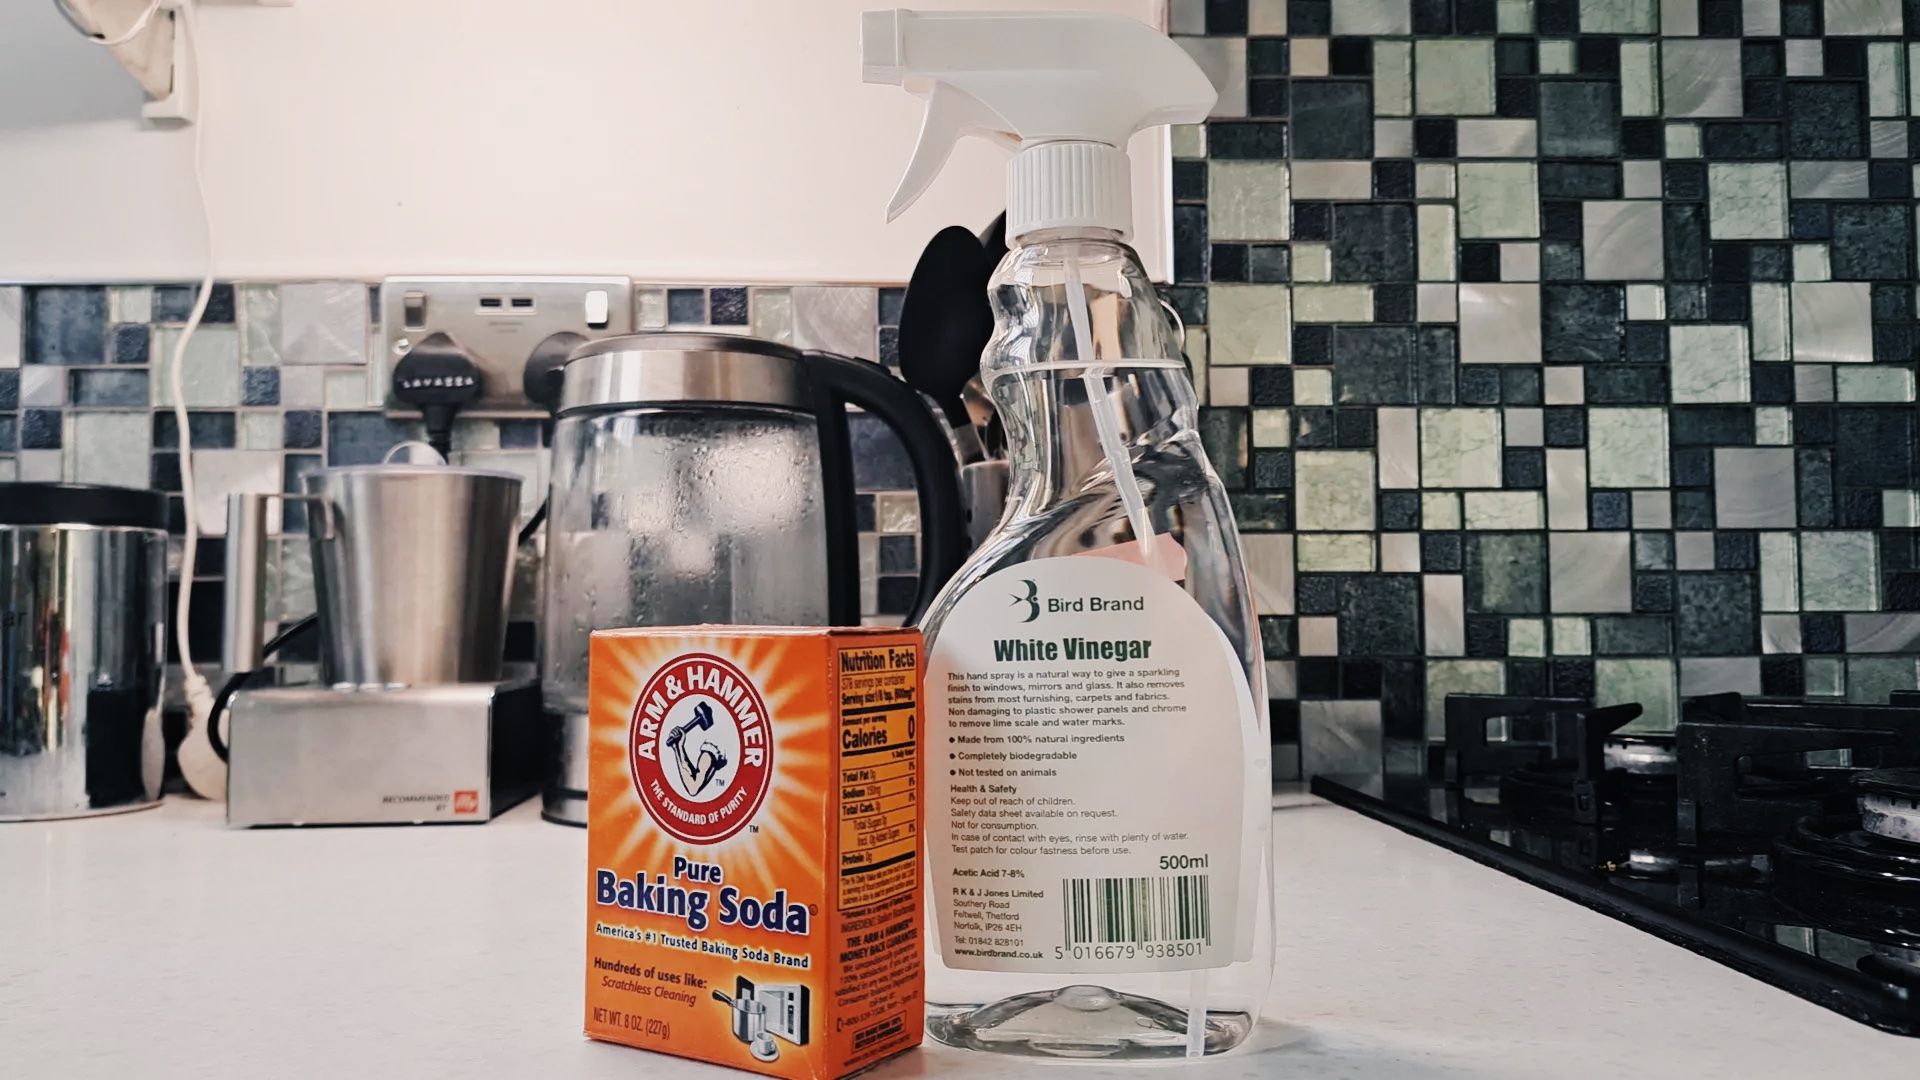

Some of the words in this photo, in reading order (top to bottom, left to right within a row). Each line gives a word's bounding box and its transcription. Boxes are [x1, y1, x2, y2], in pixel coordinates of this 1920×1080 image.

[403, 375, 474, 388] LAVAZZA
[1048, 598, 1083, 612] Bird
[1090, 597, 1143, 611] Brand
[994, 639, 1057, 661] White
[1063, 638, 1151, 662] Vinegar
[840, 650, 886, 673] Nutrition
[888, 648, 915, 669] Facts
[967, 672, 988, 680] hand
[990, 673, 1015, 681] spray
[1017, 671, 1025, 679] is
[1036, 670, 1069, 678] natural
[1106, 669, 1126, 679] give
[1137, 668, 1180, 678] sparkling
[948, 684, 970, 692] finish
[983, 683, 1025, 692] windows,
[1065, 682, 1083, 690] and
[1086, 682, 1113, 691] glass.
[1125, 681, 1144, 689] also
[948, 696, 972, 704] stains
[1023, 694, 1073, 703] furnishing,
[1076, 694, 1112, 703] carpets
[1115, 693, 1132, 701] and
[638, 689, 669, 761] ARM
[664, 674, 686, 700] &
[686, 665, 764, 768] HAMMER
[967, 707, 1010, 717] damaging
[1025, 707, 1056, 716] plastic
[1059, 706, 1094, 714] shower
[1097, 705, 1128, 715] panels
[1132, 705, 1149, 713] and
[993, 719, 1012, 727] lime
[1015, 719, 1039, 727] scale
[1042, 718, 1059, 726] and
[842, 726, 887, 749] Calories
[1007, 735, 1032, 743] 100%
[1035, 735, 1068, 743] natural
[1071, 734, 1125, 744] ingredients
[958, 752, 1007, 761] Completely
[1010, 751, 1077, 761] biodegradable
[959, 768, 974, 776] Not
[1021, 768, 1057, 776] animals
[980, 785, 986, 793] &
[989, 785, 1016, 794] Safety
[650, 779, 664, 801] THE
[662, 796, 707, 825] STANDARD
[708, 812, 719, 824] OF
[720, 786, 748, 819] PURITY
[951, 796, 971, 806] Keep
[989, 797, 997, 805] of
[1026, 797, 1035, 805] of
[1037, 797, 1075, 805] children.
[951, 808, 976, 819] Safety
[978, 809, 996, 817] data
[1081, 810, 1117, 819] request.
[951, 821, 965, 829] Not
[967, 821, 979, 829] for
[981, 822, 1038, 831] consumption.
[982, 833, 990, 841] of
[1028, 834, 1046, 842] with
[1049, 836, 1072, 844] eyes,
[1075, 834, 1097, 842] rinse
[1100, 833, 1119, 842] with
[1122, 833, 1149, 843] plenty
[1152, 832, 1160, 841] of
[952, 844, 968, 853] Test
[970, 846, 993, 855] patch
[996, 846, 1007, 854] for
[1010, 846, 1037, 854] colour
[1080, 846, 1109, 854] before
[1160, 854, 1208, 870] 500ml
[674, 856, 722, 883] Pure
[953, 868, 978, 876] Acetic
[980, 869, 999, 877] Acid
[1001, 869, 1024, 878] 7-8%
[984, 889, 1009, 897] Jones
[1012, 890, 1044, 898] Limited
[597, 869, 708, 930] Baking
[719, 887, 807, 934] Soda
[953, 899, 987, 911] Southery
[989, 900, 1010, 908] Road
[954, 910, 983, 920] Feltwell,
[986, 911, 1019, 920] Thetford
[954, 922, 983, 931] Norfolk,
[985, 923, 1003, 931] IP26
[1005, 924, 1022, 932] 4EH
[596, 923, 642, 941] America's
[645, 932, 657, 943] #1
[661, 934, 698, 950] Trusted
[701, 938, 738, 960] Baking
[742, 947, 770, 963] Soda
[773, 953, 809, 969] Brand
[969, 937, 992, 945] 01842
[995, 938, 1023, 946] 828101
[953, 949, 1043, 961] www.birdbrand.co.uk
[1055, 946, 1063, 959] 5
[1073, 945, 1134, 959] 016679
[1144, 941, 1201, 958] 938501
[594, 957, 641, 977] Hundreds
[644, 967, 656, 979] of
[657, 971, 681, 984] uses
[684, 973, 708, 989] like:
[601, 975, 651, 996] Scratchless
[654, 986, 697, 1008] Cleaning
[593, 1007, 607, 1024] NET
[609, 1010, 622, 1027] WT.
[624, 1014, 629, 1029] 8
[645, 1018, 671, 1041] (227g)
